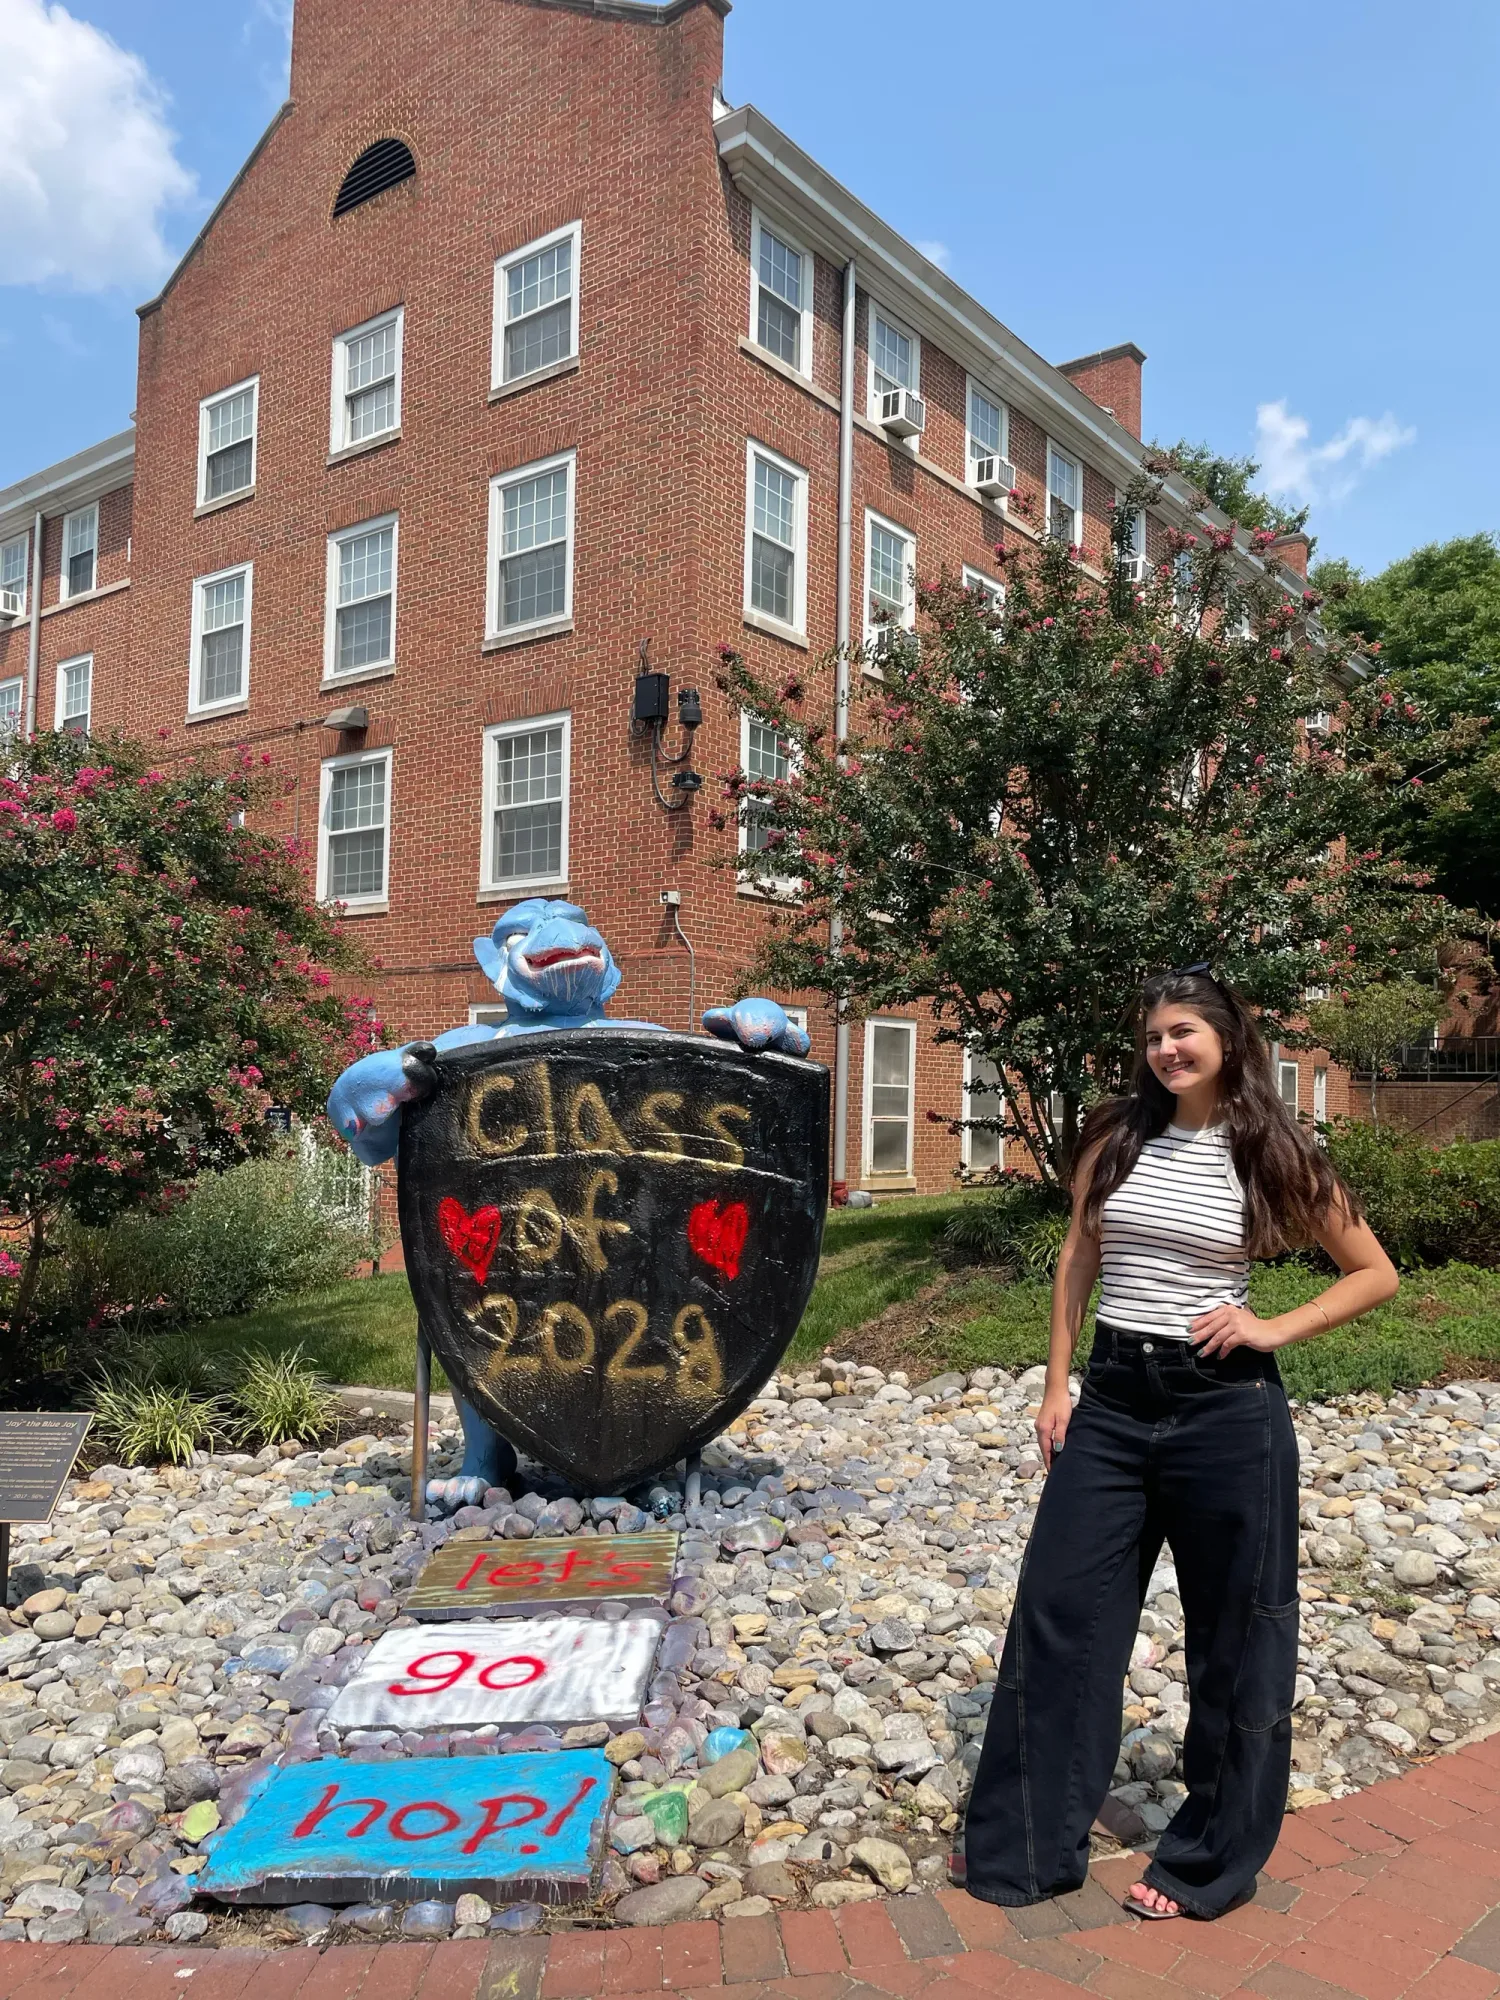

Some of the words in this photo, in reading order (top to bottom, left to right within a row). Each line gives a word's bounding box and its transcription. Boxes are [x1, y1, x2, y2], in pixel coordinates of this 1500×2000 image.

[465, 1060, 754, 1166] Class
[513, 1168, 632, 1274] of
[463, 1291, 726, 1401] 2028
[455, 1549, 653, 1591] let's
[387, 1650, 549, 1696] go
[293, 1776, 598, 1855] hop!
